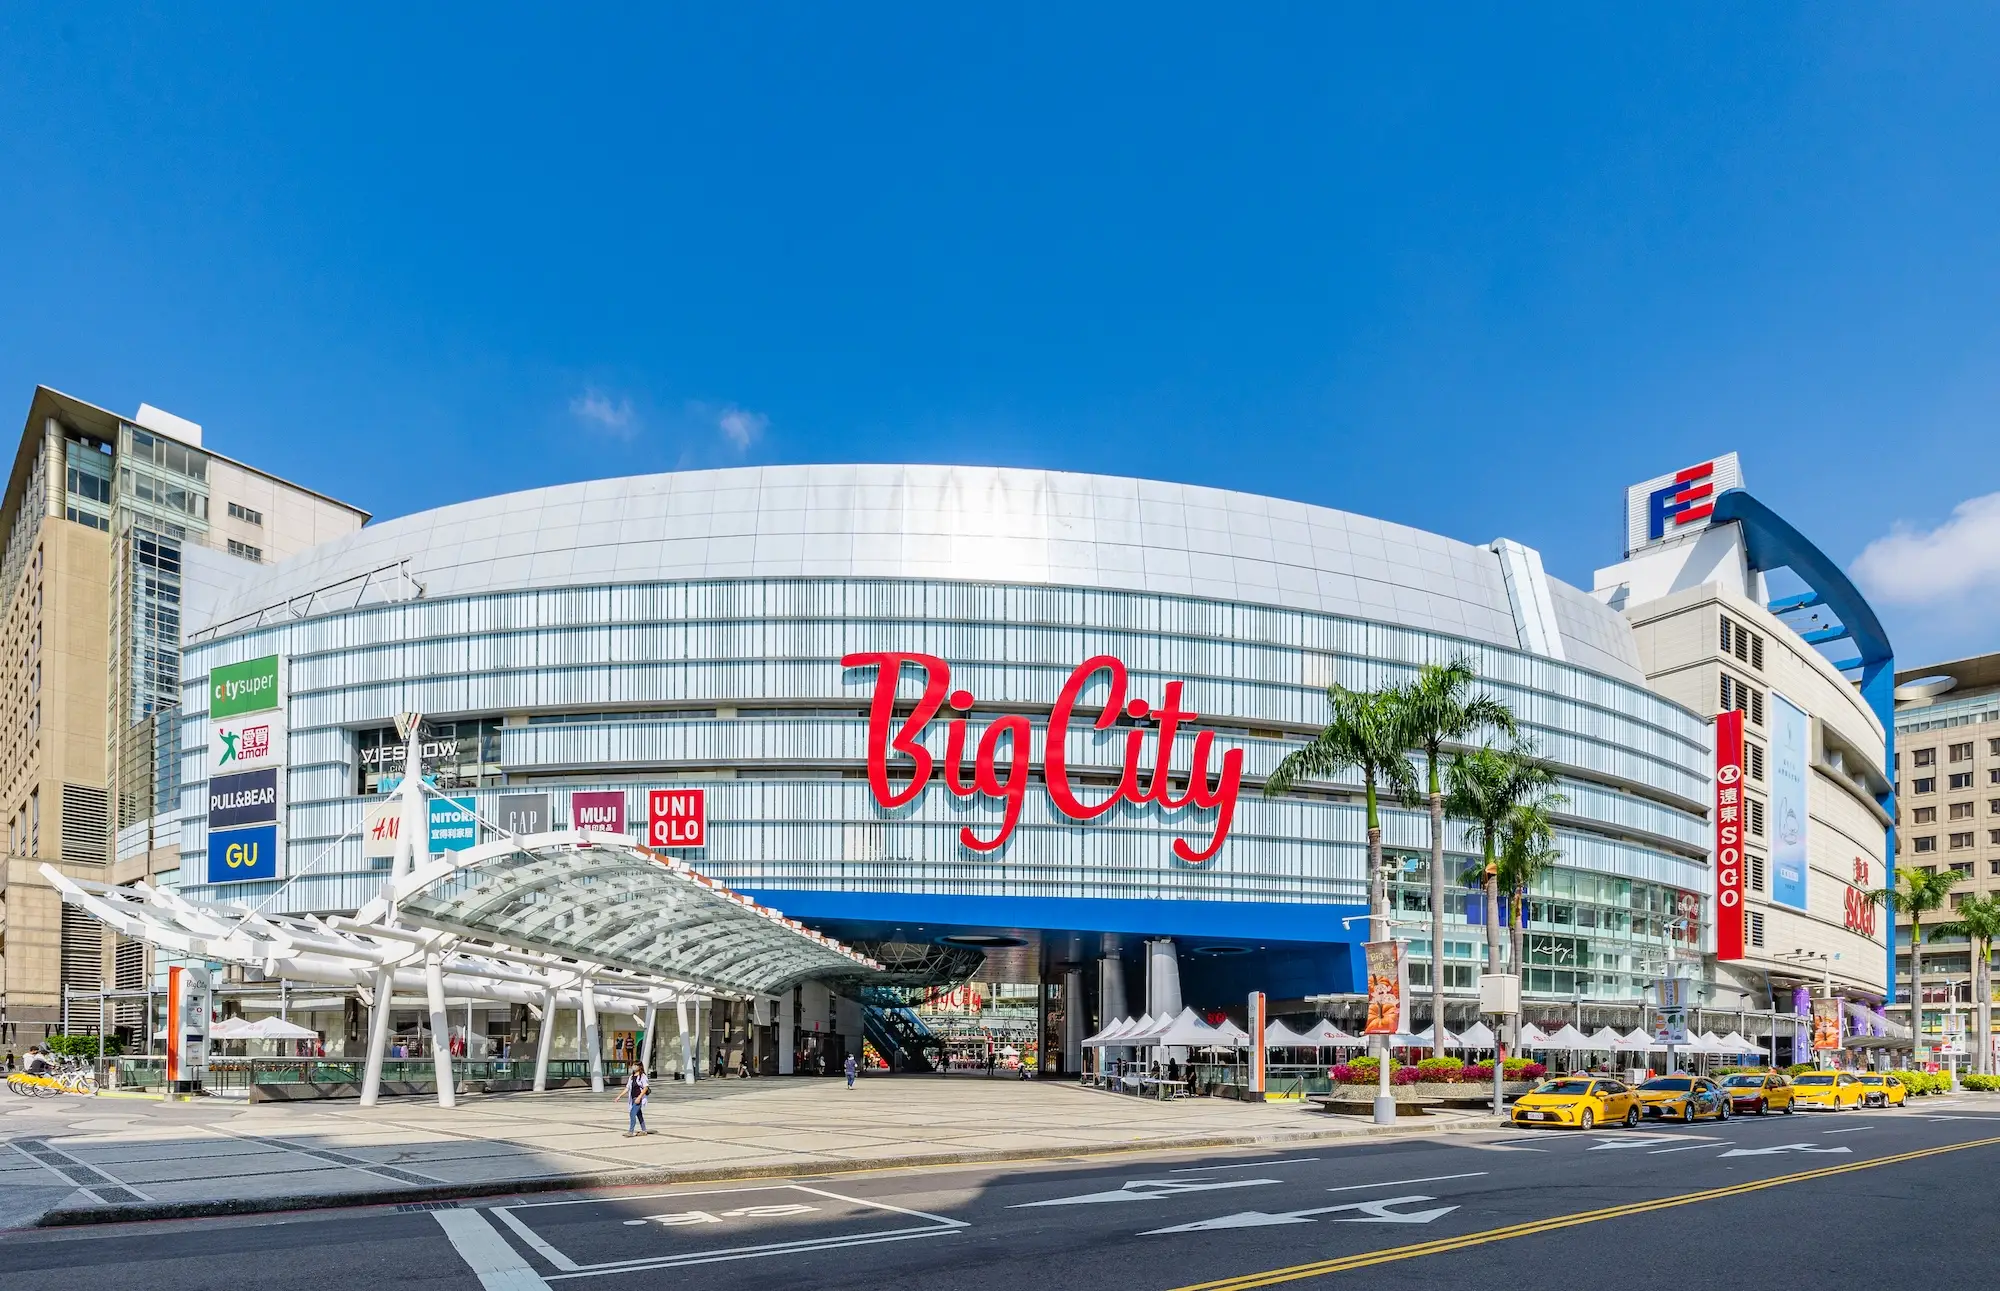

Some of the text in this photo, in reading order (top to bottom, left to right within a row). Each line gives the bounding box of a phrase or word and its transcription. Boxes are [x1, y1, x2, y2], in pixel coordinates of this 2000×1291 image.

[360, 741, 460, 764] VIESOW
[840, 652, 1243, 862] Big City
[377, 773, 438, 793] IMX
[210, 787, 275, 811] PULL&BEAR
[654, 796, 696, 816] UNI
[509, 810, 537, 834] GAP
[580, 806, 617, 823] MUJI
[371, 816, 400, 841] H&M
[431, 827, 474, 840] 宜得利家居
[654, 820, 700, 844] QLO
[226, 842, 257, 868] GU
[1719, 787, 1739, 907] 遠東 SOGO
